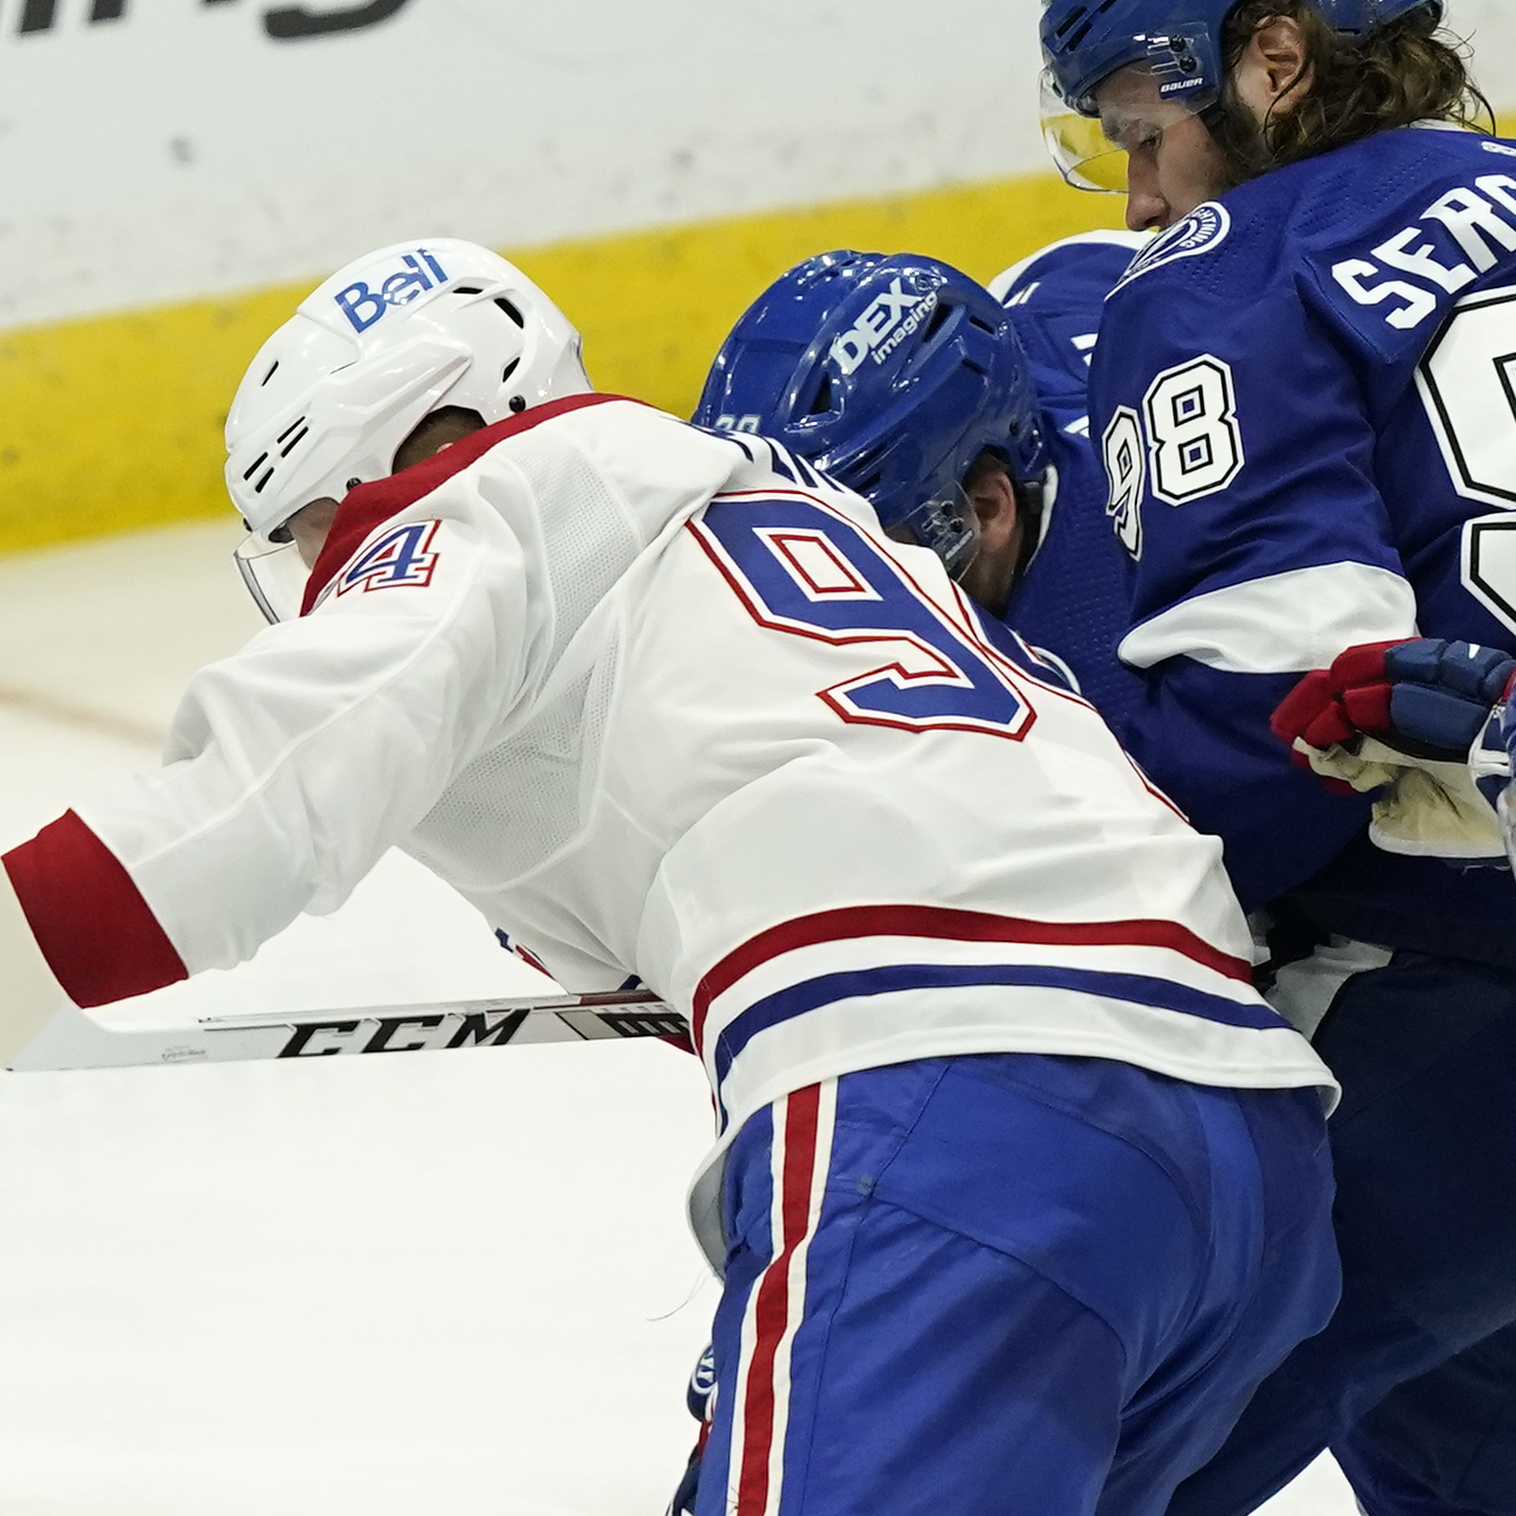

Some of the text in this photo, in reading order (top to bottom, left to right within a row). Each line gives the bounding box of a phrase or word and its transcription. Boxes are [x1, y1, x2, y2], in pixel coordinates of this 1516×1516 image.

[334, 247, 449, 335] Bell
[829, 276, 919, 376] DEX
[1102, 354, 1245, 562] 98
[277, 1007, 531, 1059] CCM
